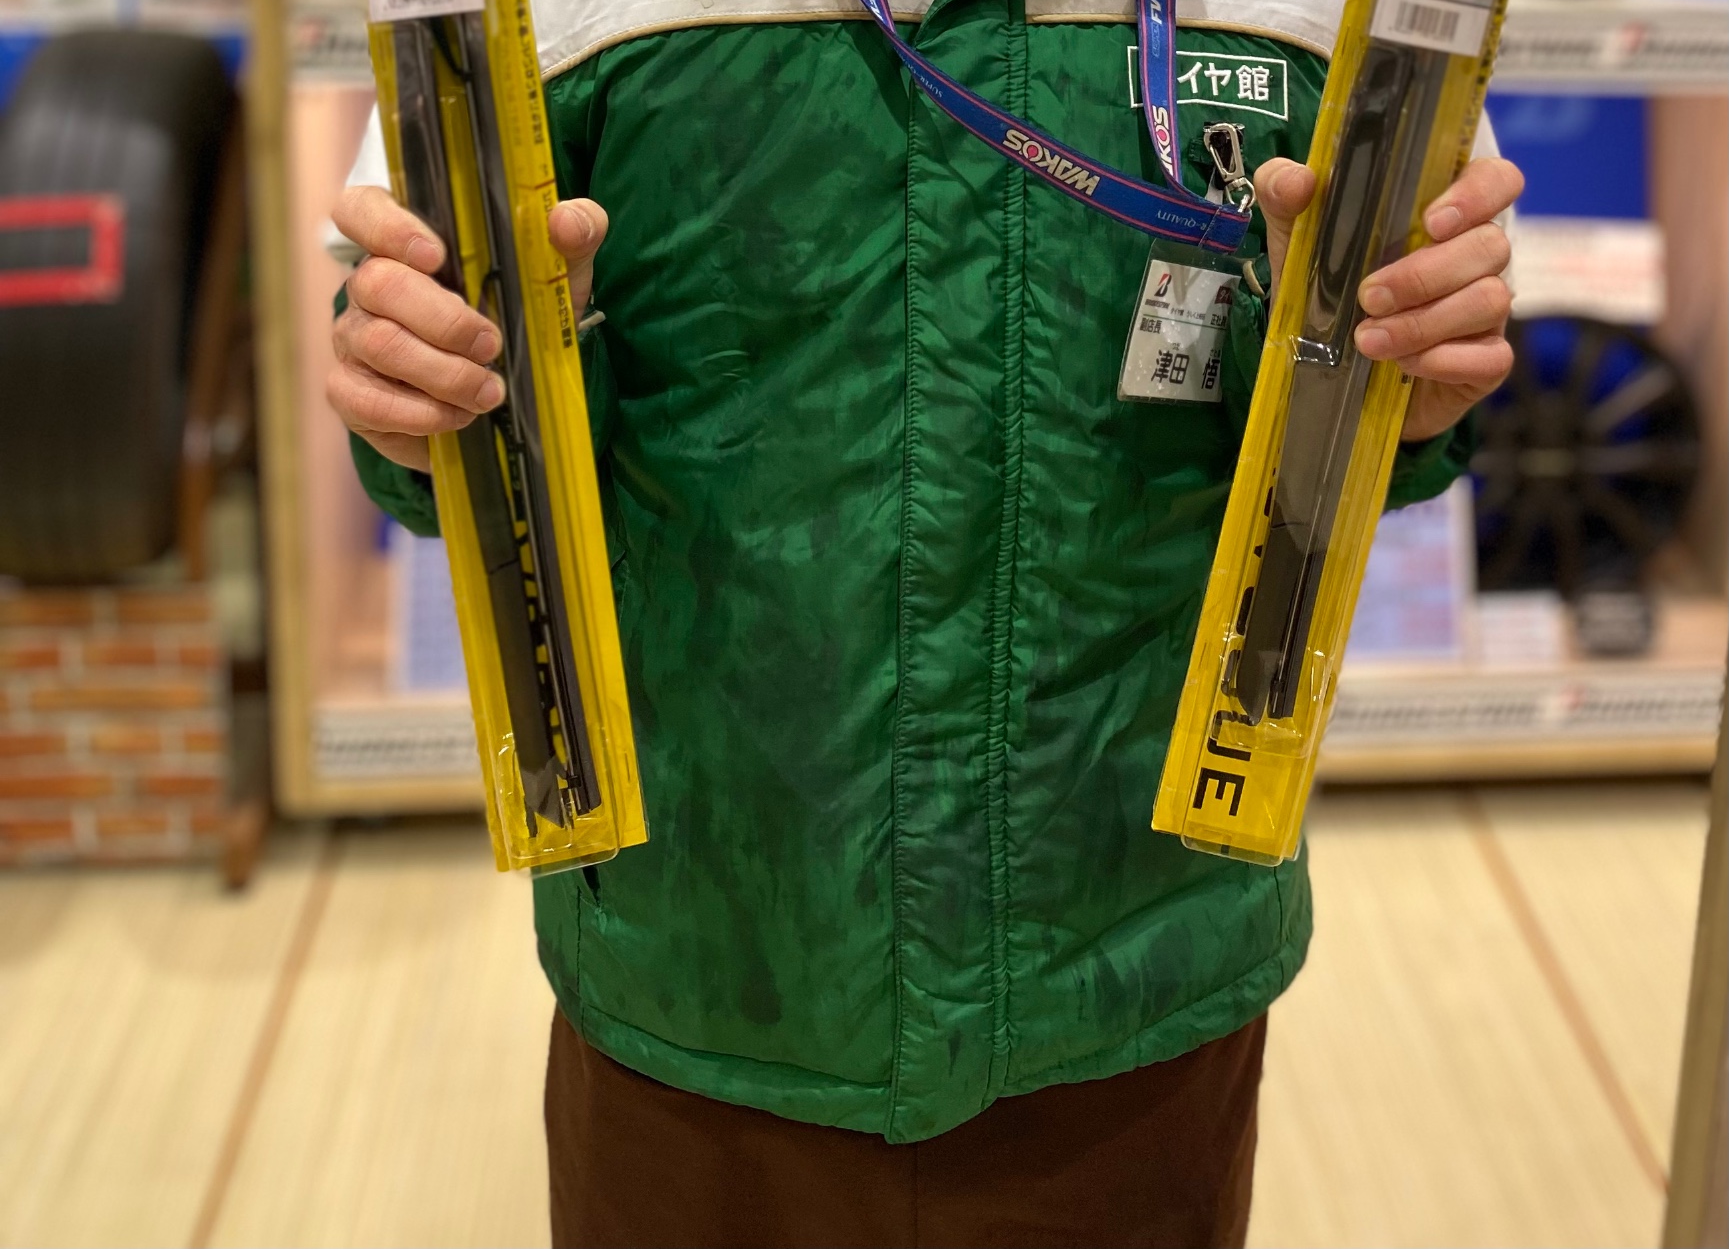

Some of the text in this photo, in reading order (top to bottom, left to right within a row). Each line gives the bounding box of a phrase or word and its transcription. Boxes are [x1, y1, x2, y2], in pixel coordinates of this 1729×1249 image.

[1177, 62, 1270, 101] イヤ館
[1151, 350, 1190, 384] 津田
